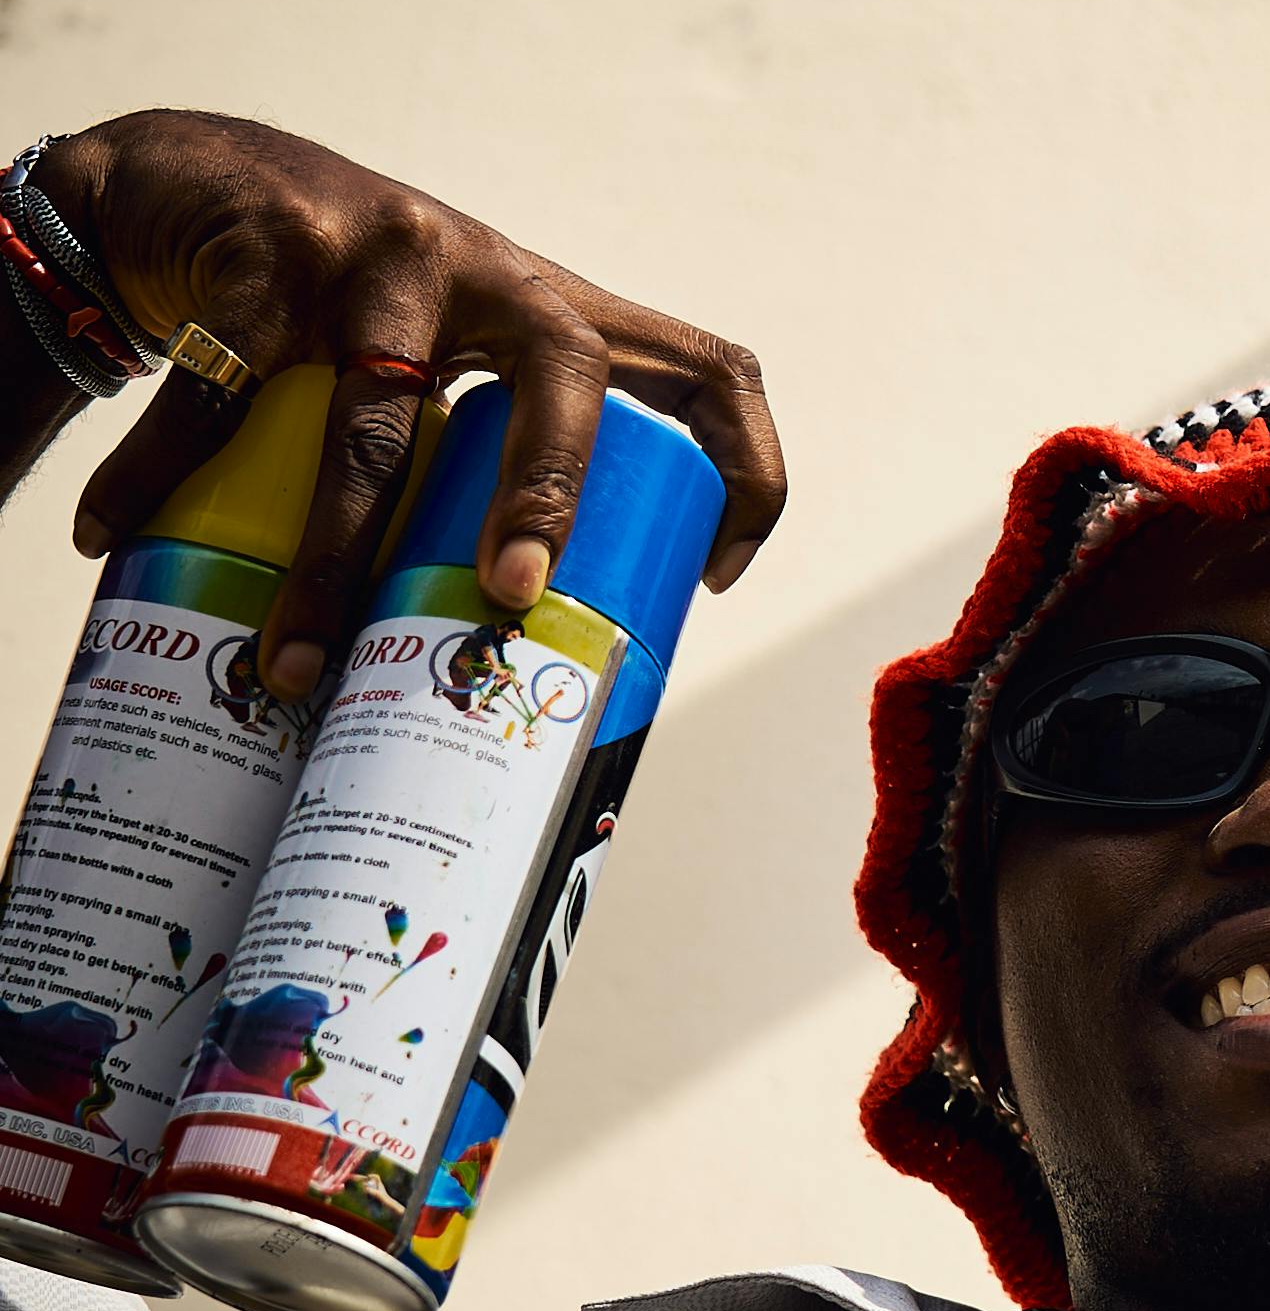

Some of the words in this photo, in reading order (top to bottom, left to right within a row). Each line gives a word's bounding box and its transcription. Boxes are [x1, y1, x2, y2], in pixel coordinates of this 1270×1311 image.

[78, 618, 200, 661] CCORD
[90, 677, 128, 694] USAGE
[129, 682, 182, 706] SCOPE:
[362, 690, 405, 705] SCOPE:
[83, 696, 119, 713] surface
[121, 703, 148, 718] such
[150, 709, 166, 722] as
[169, 712, 223, 741] vehicles,
[226, 731, 281, 763] machine,
[352, 707, 374, 720] such
[376, 709, 389, 719] as
[393, 708, 444, 729] vehicles,
[448, 720, 507, 750] machine,
[72, 734, 90, 746] and
[90, 734, 132, 754] plastics
[135, 746, 158, 761] etc.
[103, 718, 157, 740] materials
[159, 732, 190, 749] such
[192, 742, 208, 754] as
[211, 748, 250, 771] wood,
[252, 762, 284, 786] glass,
[336, 725, 380, 738] materials
[382, 728, 411, 740] such
[414, 731, 429, 742] as
[432, 734, 471, 757] wood,
[475, 749, 511, 772] glass,
[360, 744, 379, 755] etc.
[65, 805, 90, 820] spray
[90, 810, 107, 821] the
[108, 812, 141, 830] target
[143, 821, 154, 833] at
[156, 826, 190, 844] 20-30
[190, 837, 252, 868] centimeters.
[303, 824, 322, 834] Keep
[323, 823, 368, 836] repeating
[370, 826, 385, 837] for
[387, 831, 427, 848] several
[428, 842, 459, 859] times
[318, 809, 331, 818] the
[332, 809, 361, 820] target
[362, 811, 373, 820] at
[376, 812, 407, 826] 20-30
[409, 821, 475, 850] centimeters.
[73, 821, 98, 836] Keep
[99, 828, 150, 850] repeating
[151, 840, 168, 853] for
[168, 846, 208, 866] several
[209, 860, 237, 879] times
[290, 852, 302, 862] the
[303, 851, 329, 861] bottle
[331, 851, 352, 862] with
[363, 855, 390, 870] cloth
[38, 848, 61, 860] Clean
[61, 852, 77, 863] the
[78, 855, 108, 871] bottle
[110, 863, 135, 879] with
[136, 871, 144, 880] a
[145, 873, 173, 890] cloth
[12, 901, 55, 919] spraying.
[44, 888, 59, 902] try
[60, 891, 113, 915] spraying
[114, 906, 122, 915] a
[125, 908, 161, 927] small
[272, 889, 285, 899] try
[285, 887, 330, 900] spraying
[332, 890, 339, 898] a
[343, 893, 376, 905] small
[16, 922, 41, 933] when
[43, 925, 96, 947] spraying.
[268, 918, 313, 933] spraying.
[21, 938, 38, 952] dry
[38, 942, 70, 958] place
[73, 950, 86, 962] to
[87, 955, 109, 968] get
[111, 960, 149, 981] better
[260, 954, 286, 963] days.
[262, 937, 289, 948] place
[291, 936, 302, 946] to
[304, 938, 323, 950] get
[326, 939, 363, 957] better
[37, 960, 68, 977] days.
[259, 969, 266, 979] it
[266, 969, 336, 988] immediately
[338, 980, 367, 994] with
[7, 972, 35, 988] clean
[37, 977, 48, 989] it
[48, 980, 124, 1013] immediately
[125, 1003, 152, 1021] with
[17, 992, 44, 1009] help.
[321, 1029, 343, 1045] dry
[109, 1055, 132, 1073] dry
[317, 1046, 346, 1064] from
[350, 1057, 378, 1076] heat
[381, 1069, 405, 1086] and
[104, 1072, 134, 1093] from
[137, 1082, 163, 1103] heat
[222, 1095, 257, 1113] INC.
[264, 1101, 305, 1123] USA
[9, 1115, 48, 1140] INC.
[52, 1127, 96, 1154] USA
[318, 1110, 417, 1162] ACCORD
